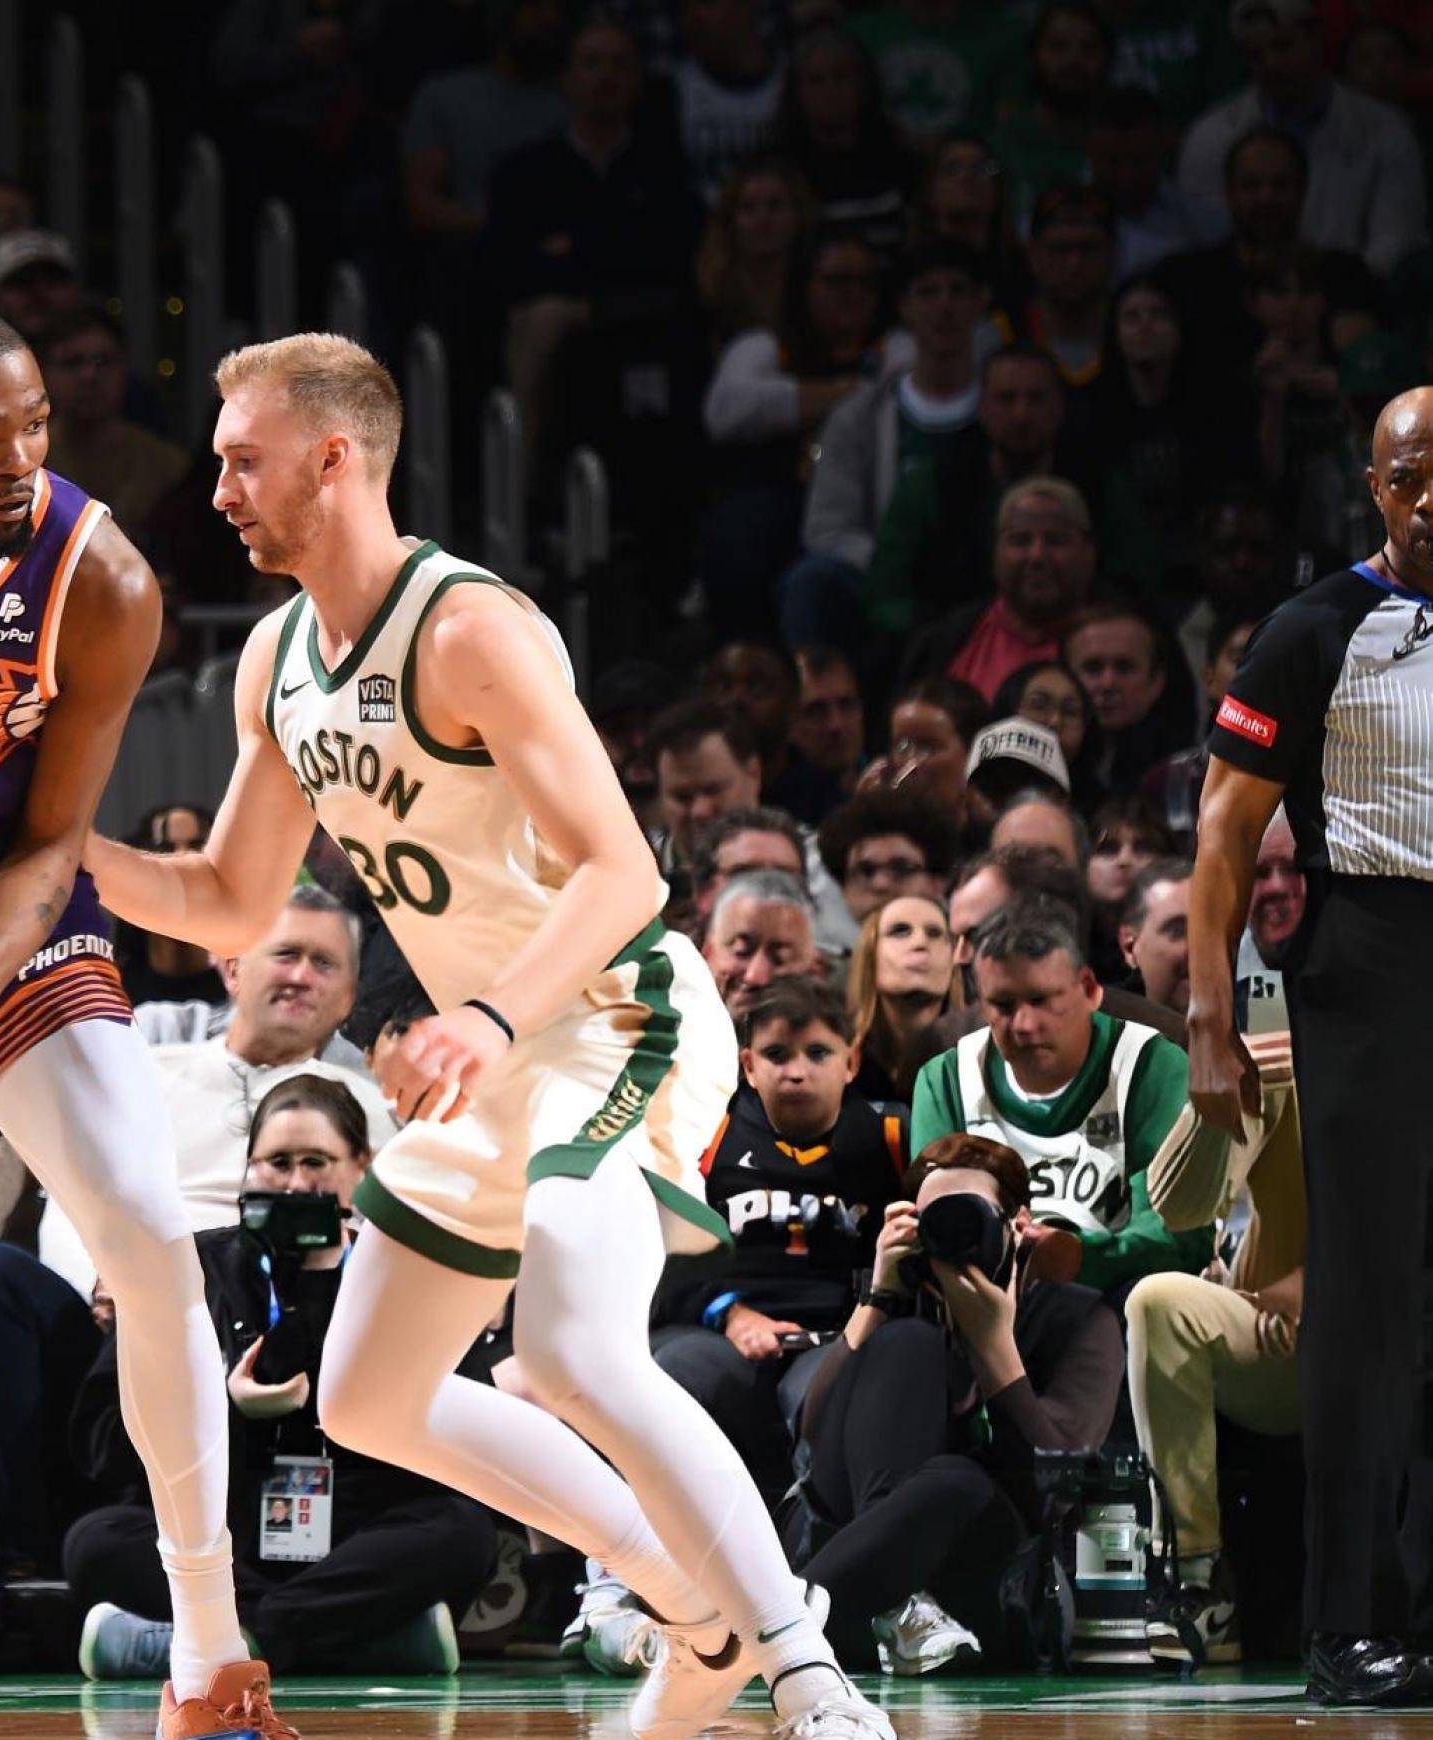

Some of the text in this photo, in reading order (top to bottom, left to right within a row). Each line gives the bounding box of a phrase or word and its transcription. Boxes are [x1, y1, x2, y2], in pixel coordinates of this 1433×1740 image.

[360, 679, 395, 702] VISTA
[361, 703, 395, 721] PRINT
[1220, 700, 1269, 738] Emirates
[290, 727, 425, 823] OSTON
[338, 835, 452, 917] 30
[18, 934, 115, 982] PHOENIX
